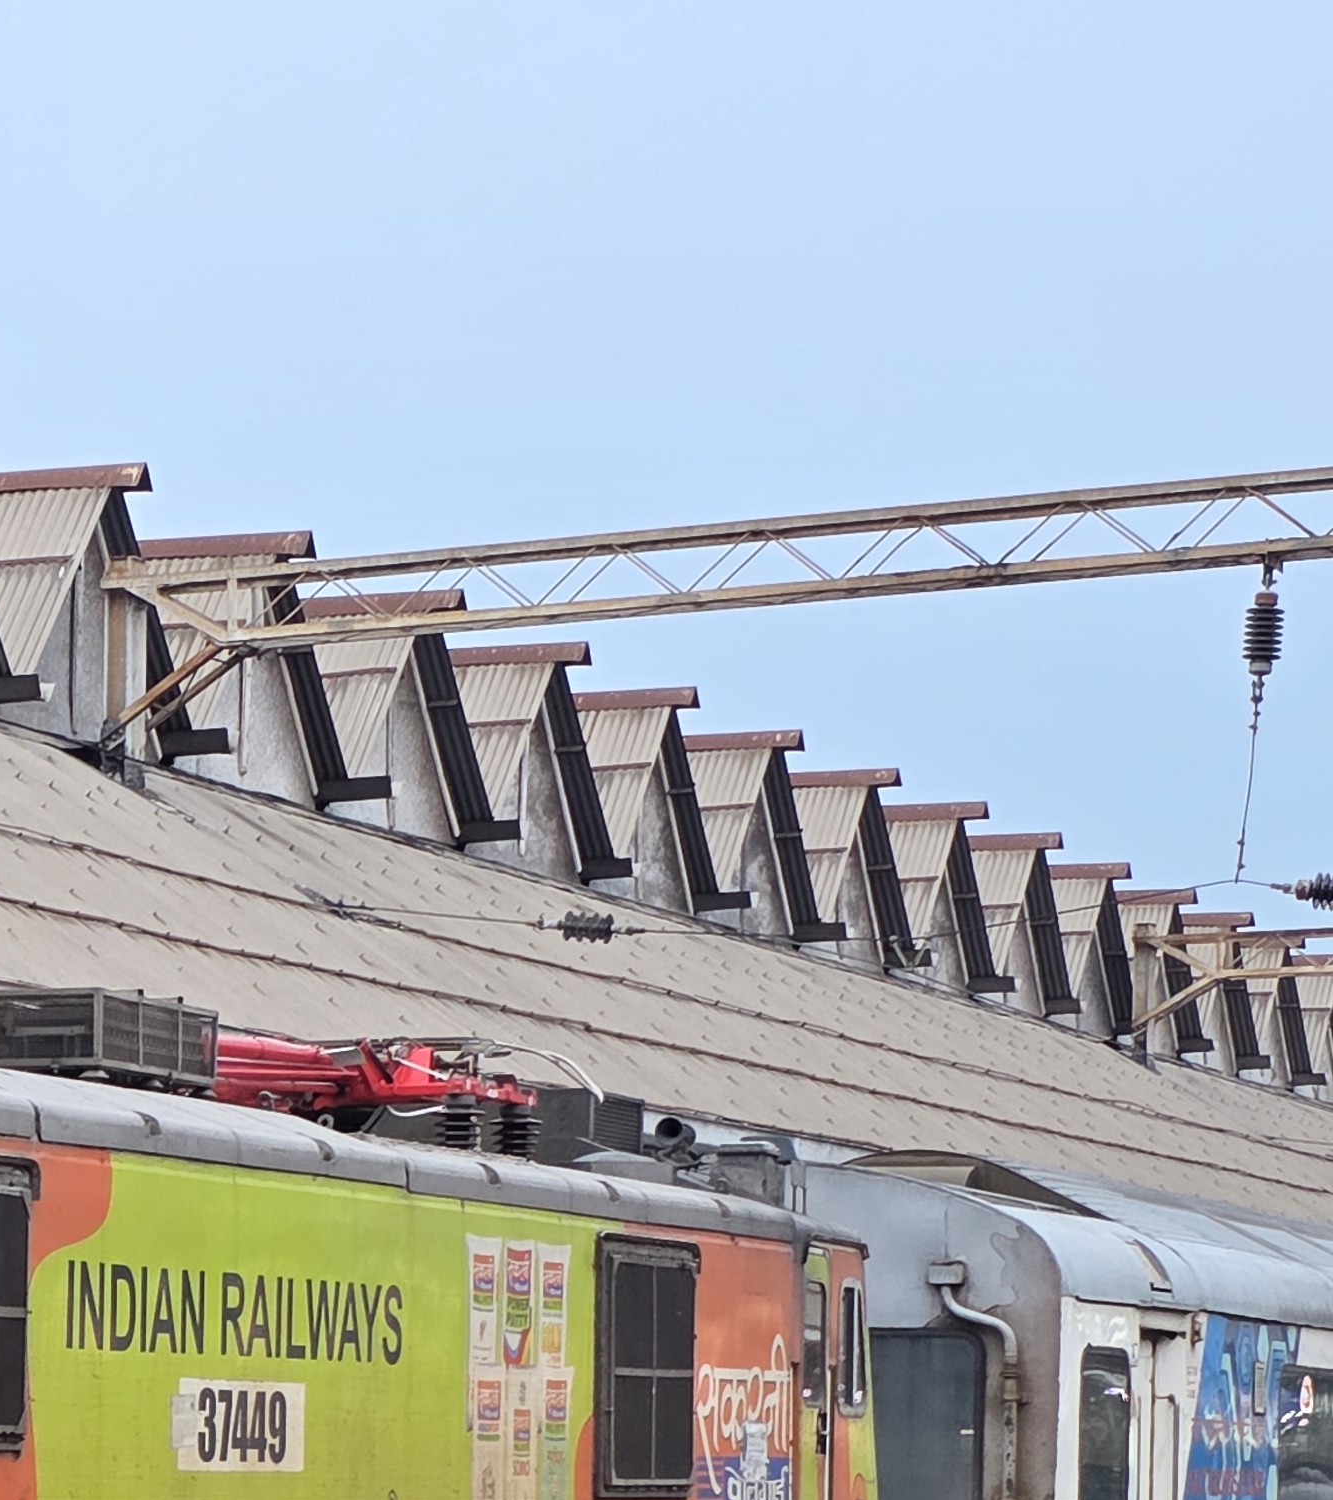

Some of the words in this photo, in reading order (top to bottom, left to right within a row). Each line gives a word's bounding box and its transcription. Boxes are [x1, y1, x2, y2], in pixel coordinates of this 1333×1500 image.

[66, 1260, 205, 1355] INDIAN
[220, 1272, 403, 1365] RAILWAYS
[197, 1387, 287, 1464] 37449
